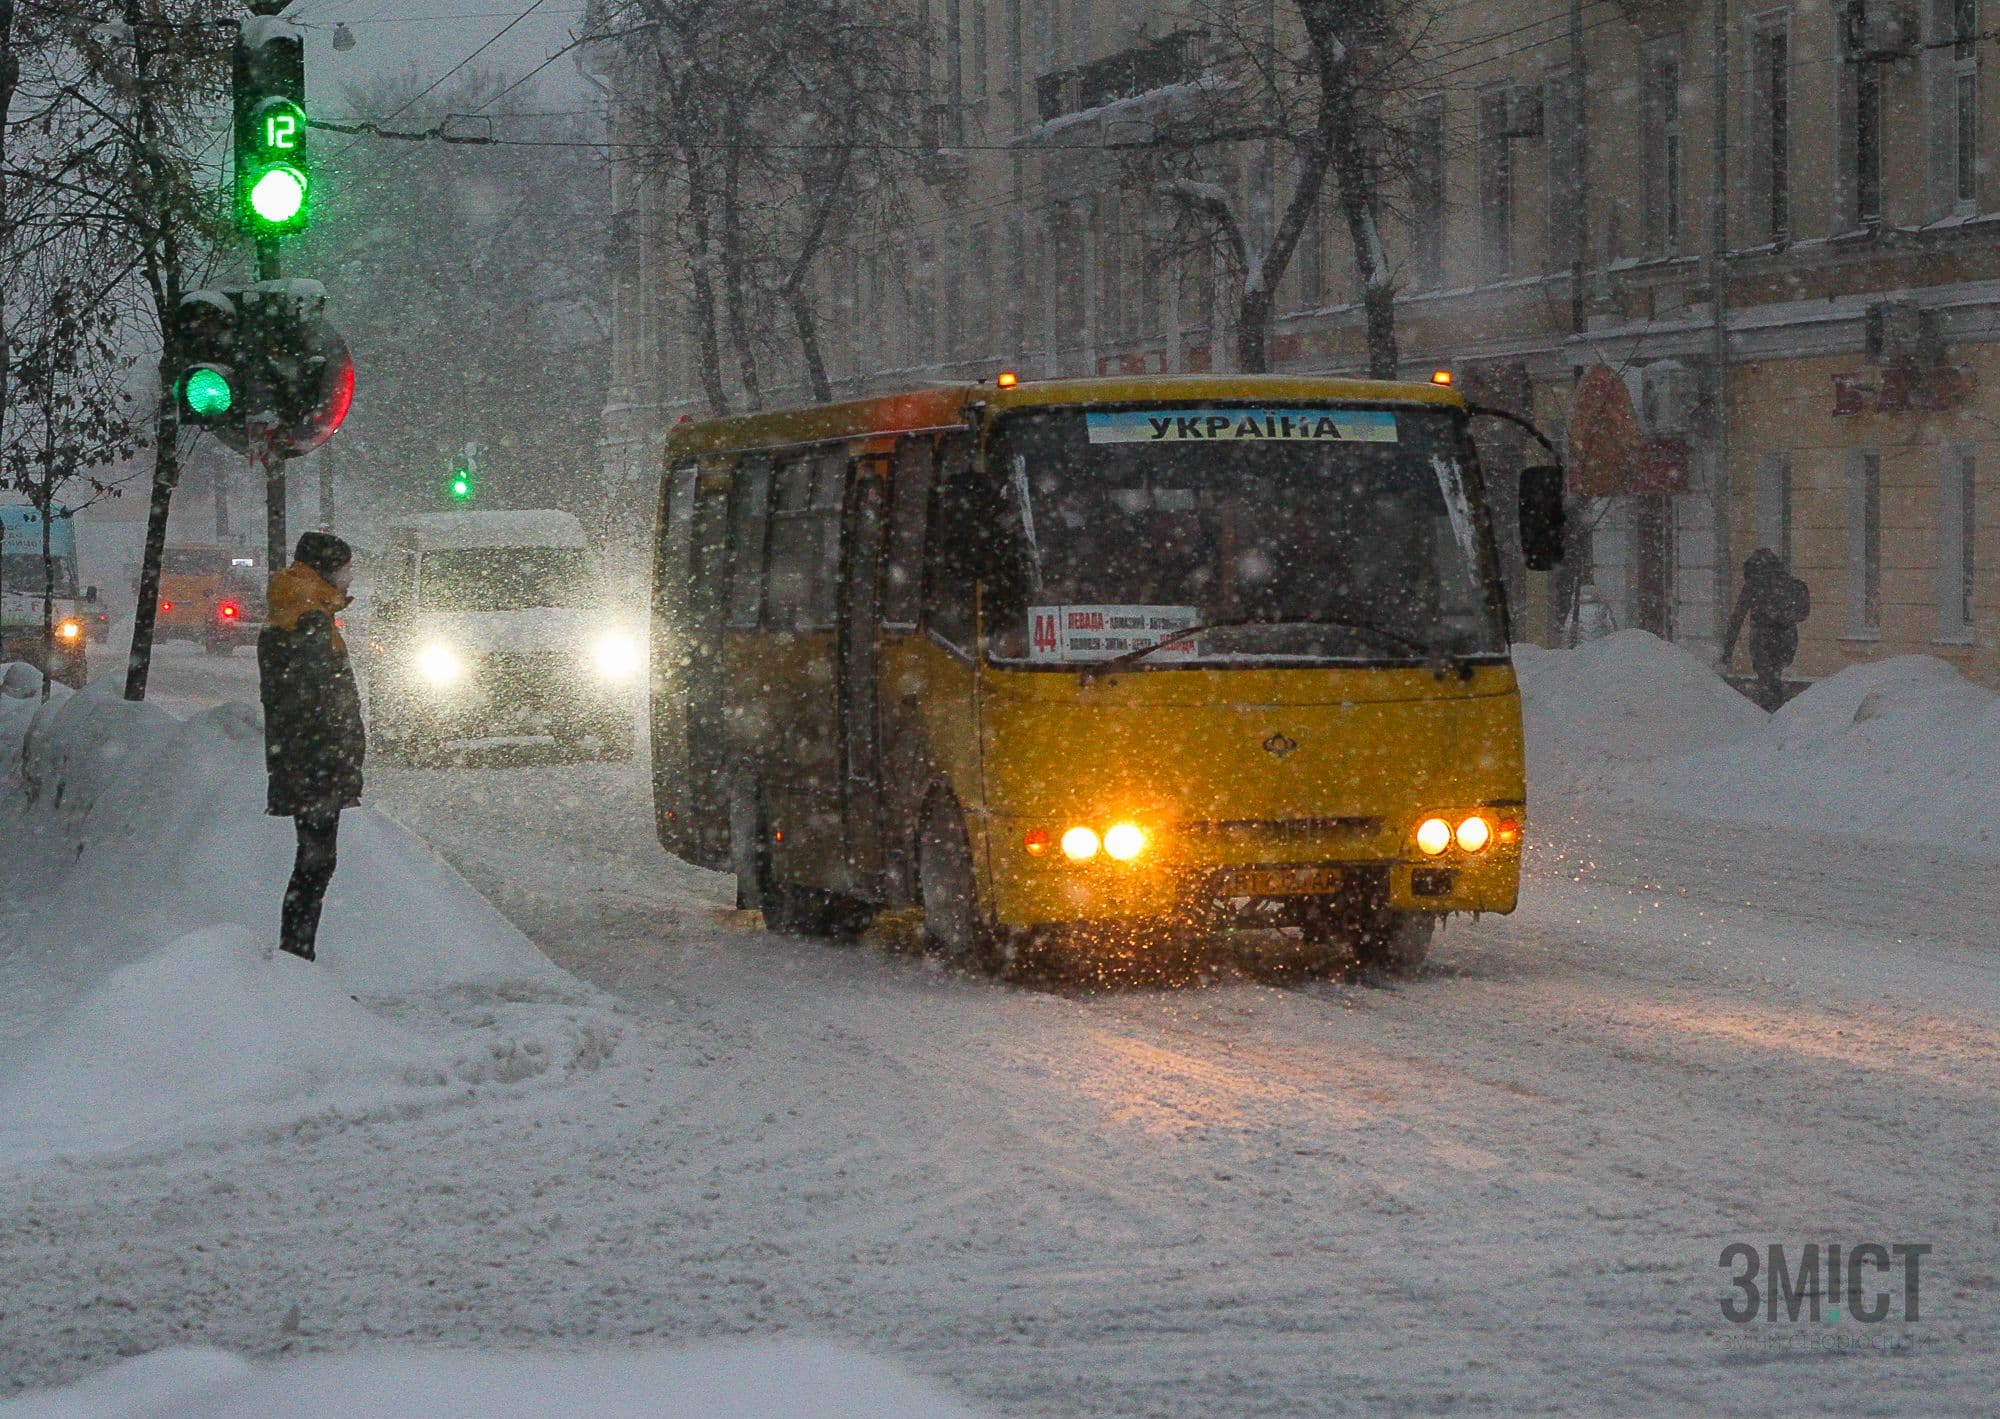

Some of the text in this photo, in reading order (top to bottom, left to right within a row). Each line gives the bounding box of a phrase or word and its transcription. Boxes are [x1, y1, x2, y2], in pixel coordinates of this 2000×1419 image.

[267, 116, 295, 148] 12
[1148, 410, 1343, 440] УКРАЇНА
[1034, 615, 1057, 653] 44
